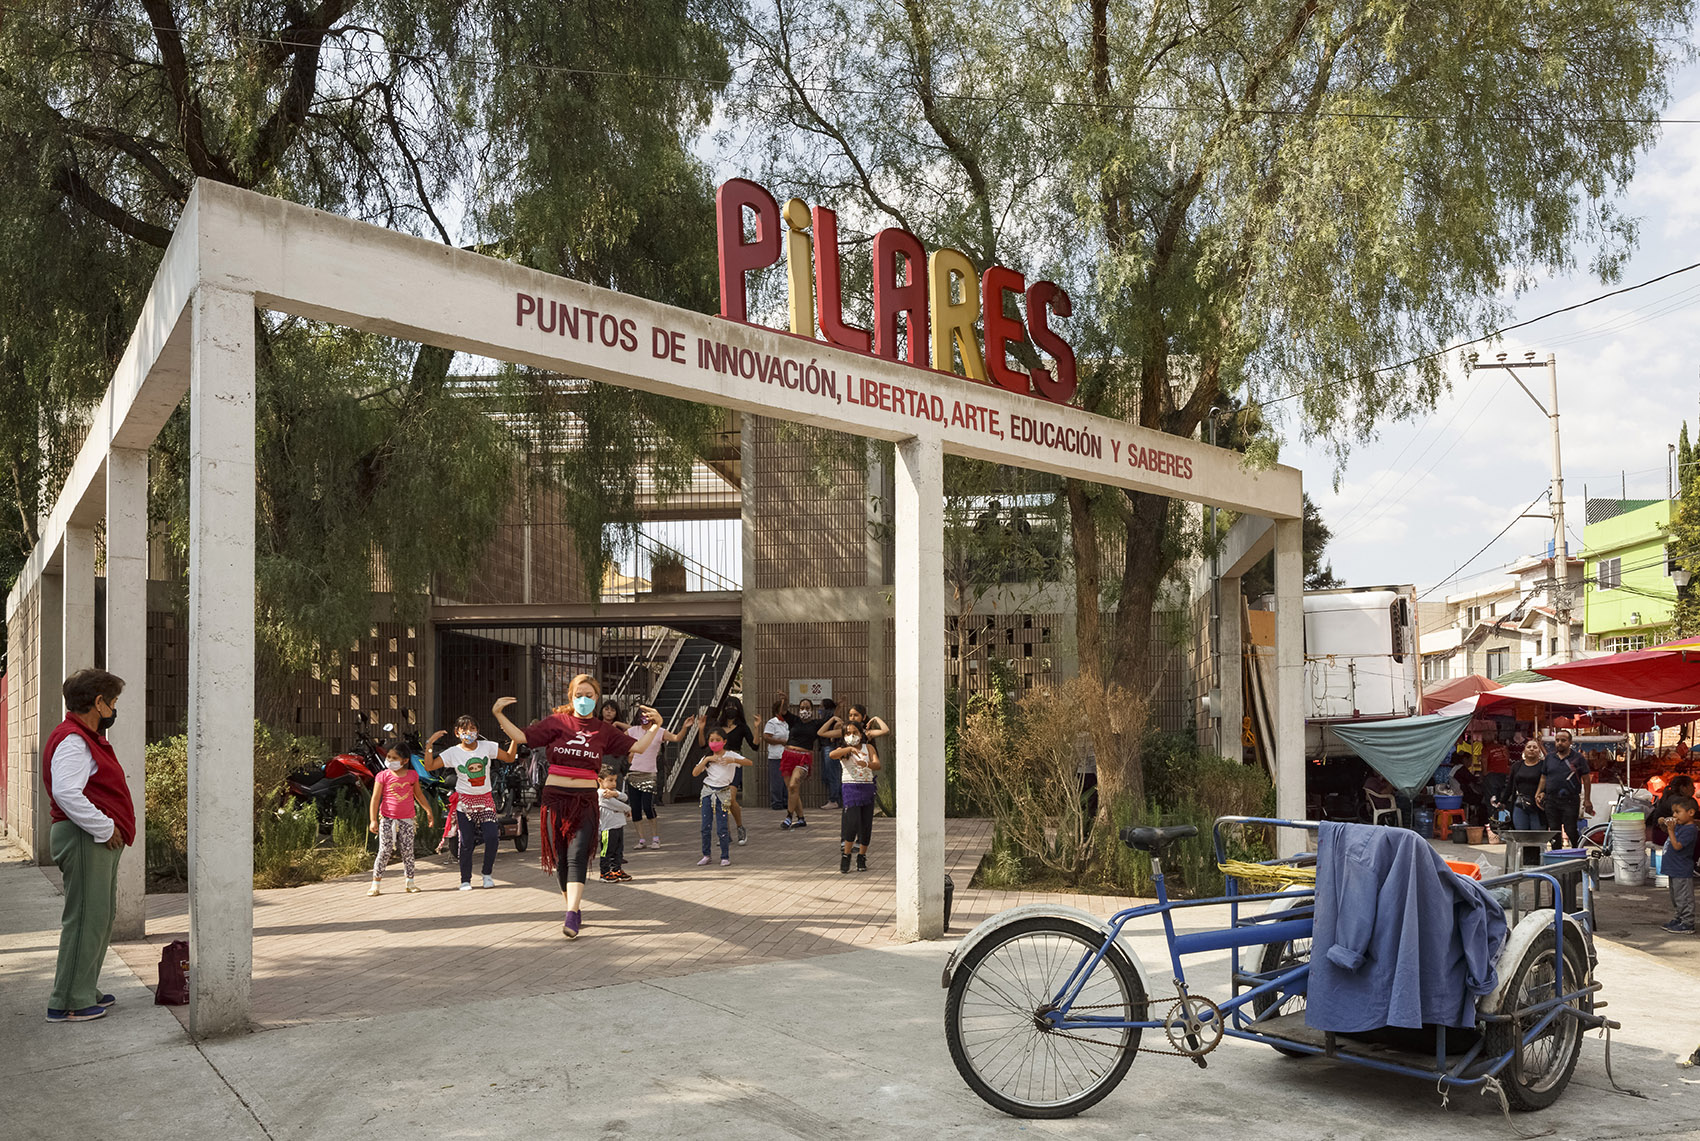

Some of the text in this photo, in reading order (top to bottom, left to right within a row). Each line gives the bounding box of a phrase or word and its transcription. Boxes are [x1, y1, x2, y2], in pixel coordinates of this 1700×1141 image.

[516, 292, 1193, 480] PUNTOS DE INNOVACIÓN, LIBERTAD, ARTE, EDUCACIÓN Y SABERES
[553, 746, 582, 757] PONTE
